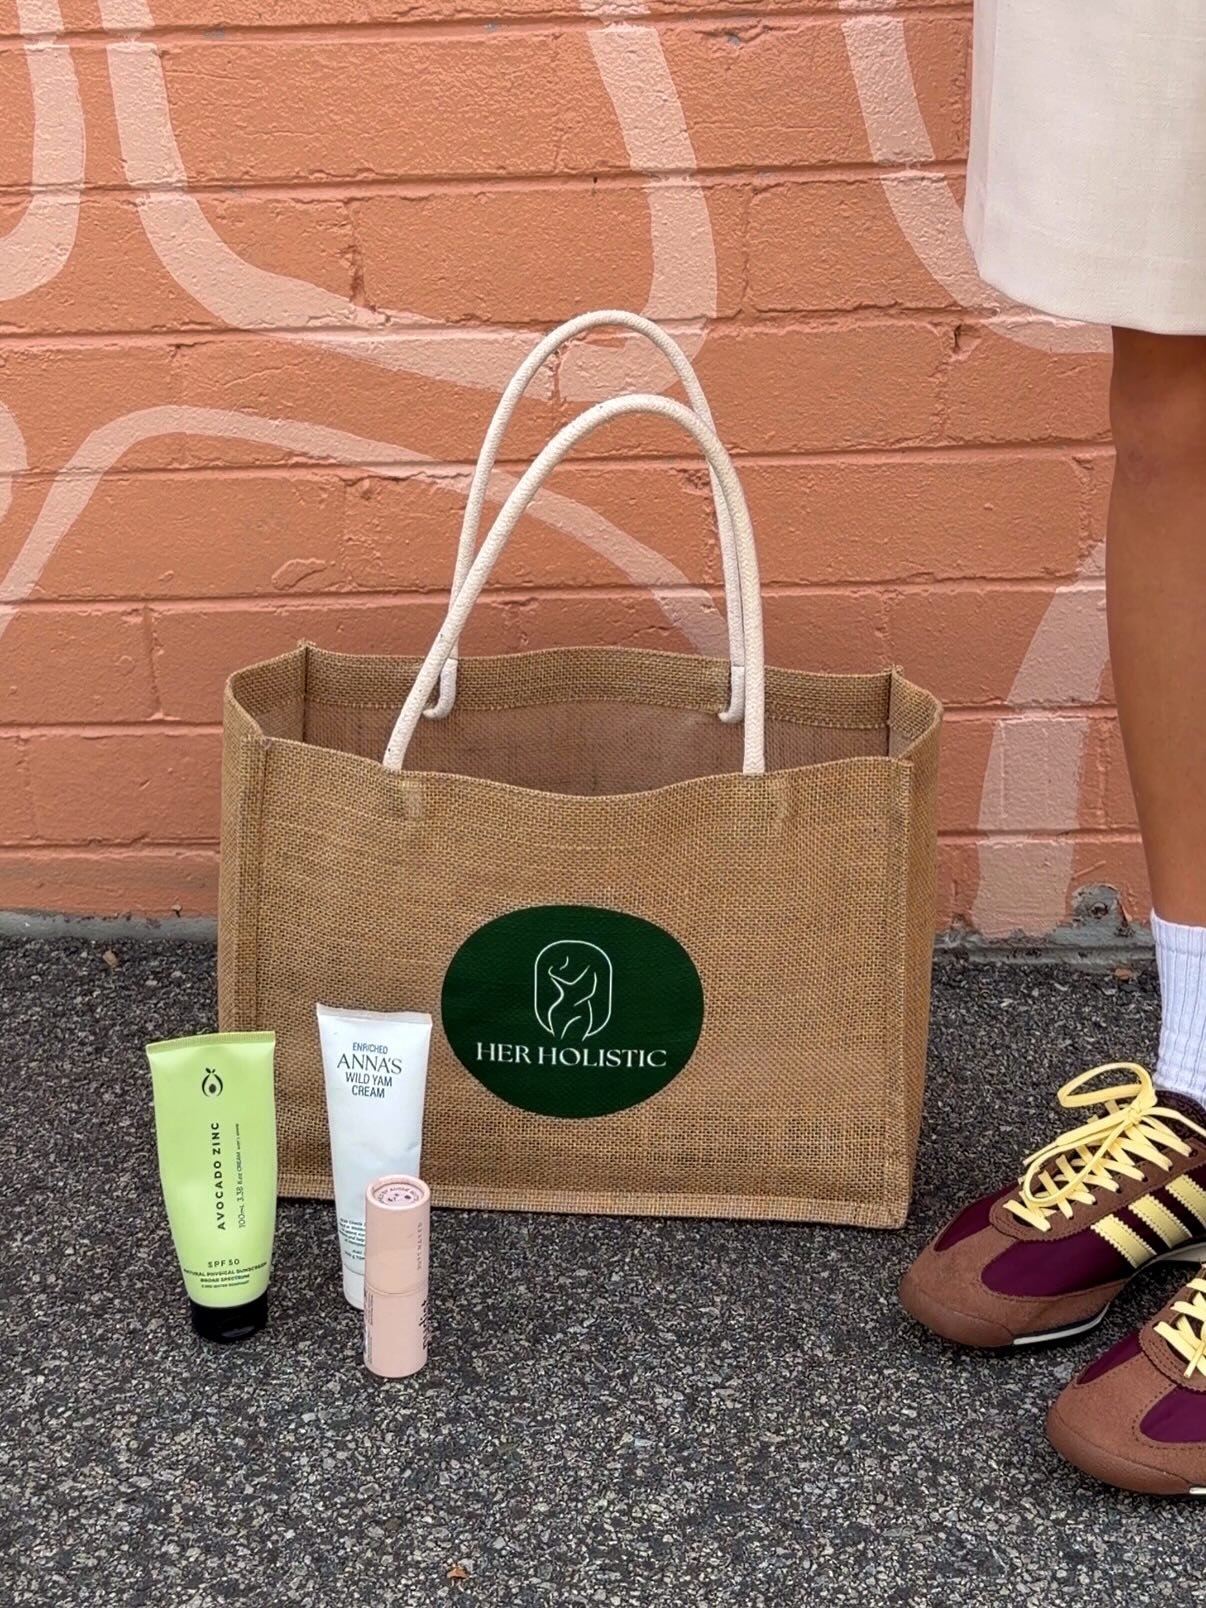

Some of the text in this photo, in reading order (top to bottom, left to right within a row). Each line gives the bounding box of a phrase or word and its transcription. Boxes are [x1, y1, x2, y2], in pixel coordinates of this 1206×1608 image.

[352, 1042, 389, 1055] ENRICHED
[476, 1042, 667, 1068] HER HOLISTIC
[337, 1053, 402, 1075] ANNA'S
[345, 1072, 393, 1087] WILD YAM
[351, 1085, 385, 1098] CREAM
[211, 1122, 226, 1231] AVOCADO ZINC
[208, 1258, 240, 1268] SPF 50
